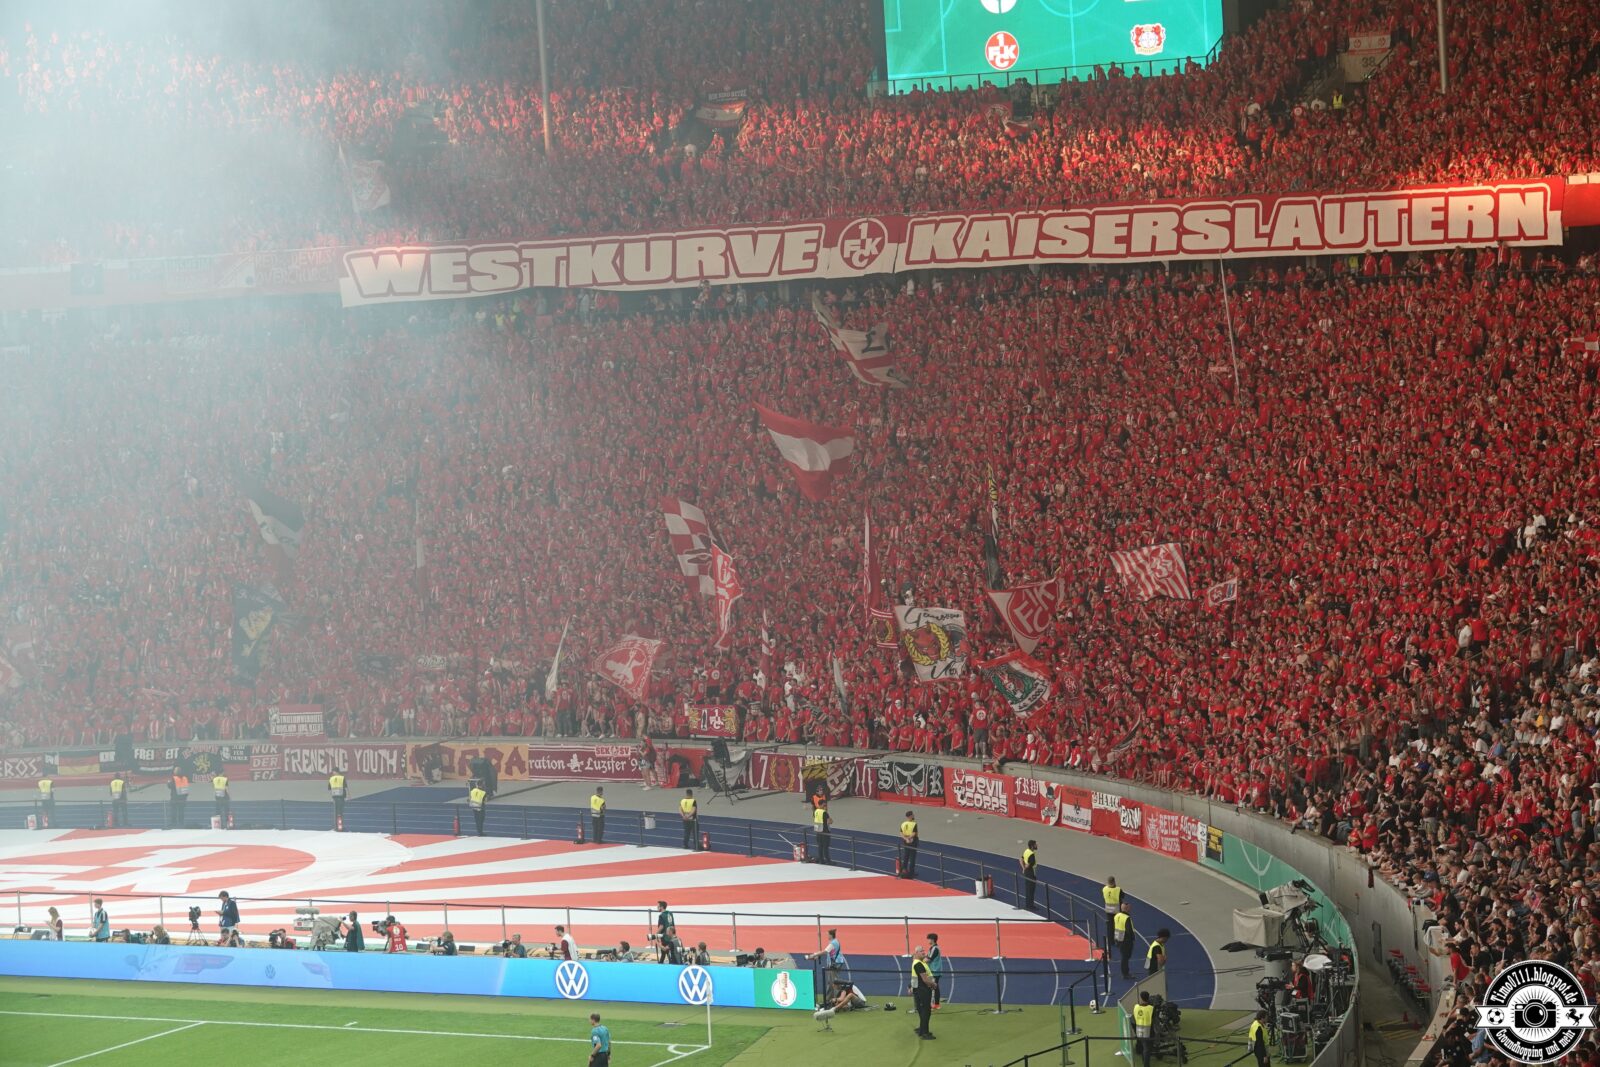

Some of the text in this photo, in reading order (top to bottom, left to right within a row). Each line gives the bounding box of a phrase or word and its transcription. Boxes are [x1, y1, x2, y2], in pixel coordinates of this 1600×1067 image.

[1361, 57, 1376, 67] 38
[908, 190, 1547, 263] KAISERSLAUTERN
[348, 229, 822, 298] WESTKURVE
[252, 744, 279, 754] NUR
[253, 757, 280, 768] DER
[284, 748, 349, 775] FRENETIC
[354, 749, 398, 774] YOUTH
